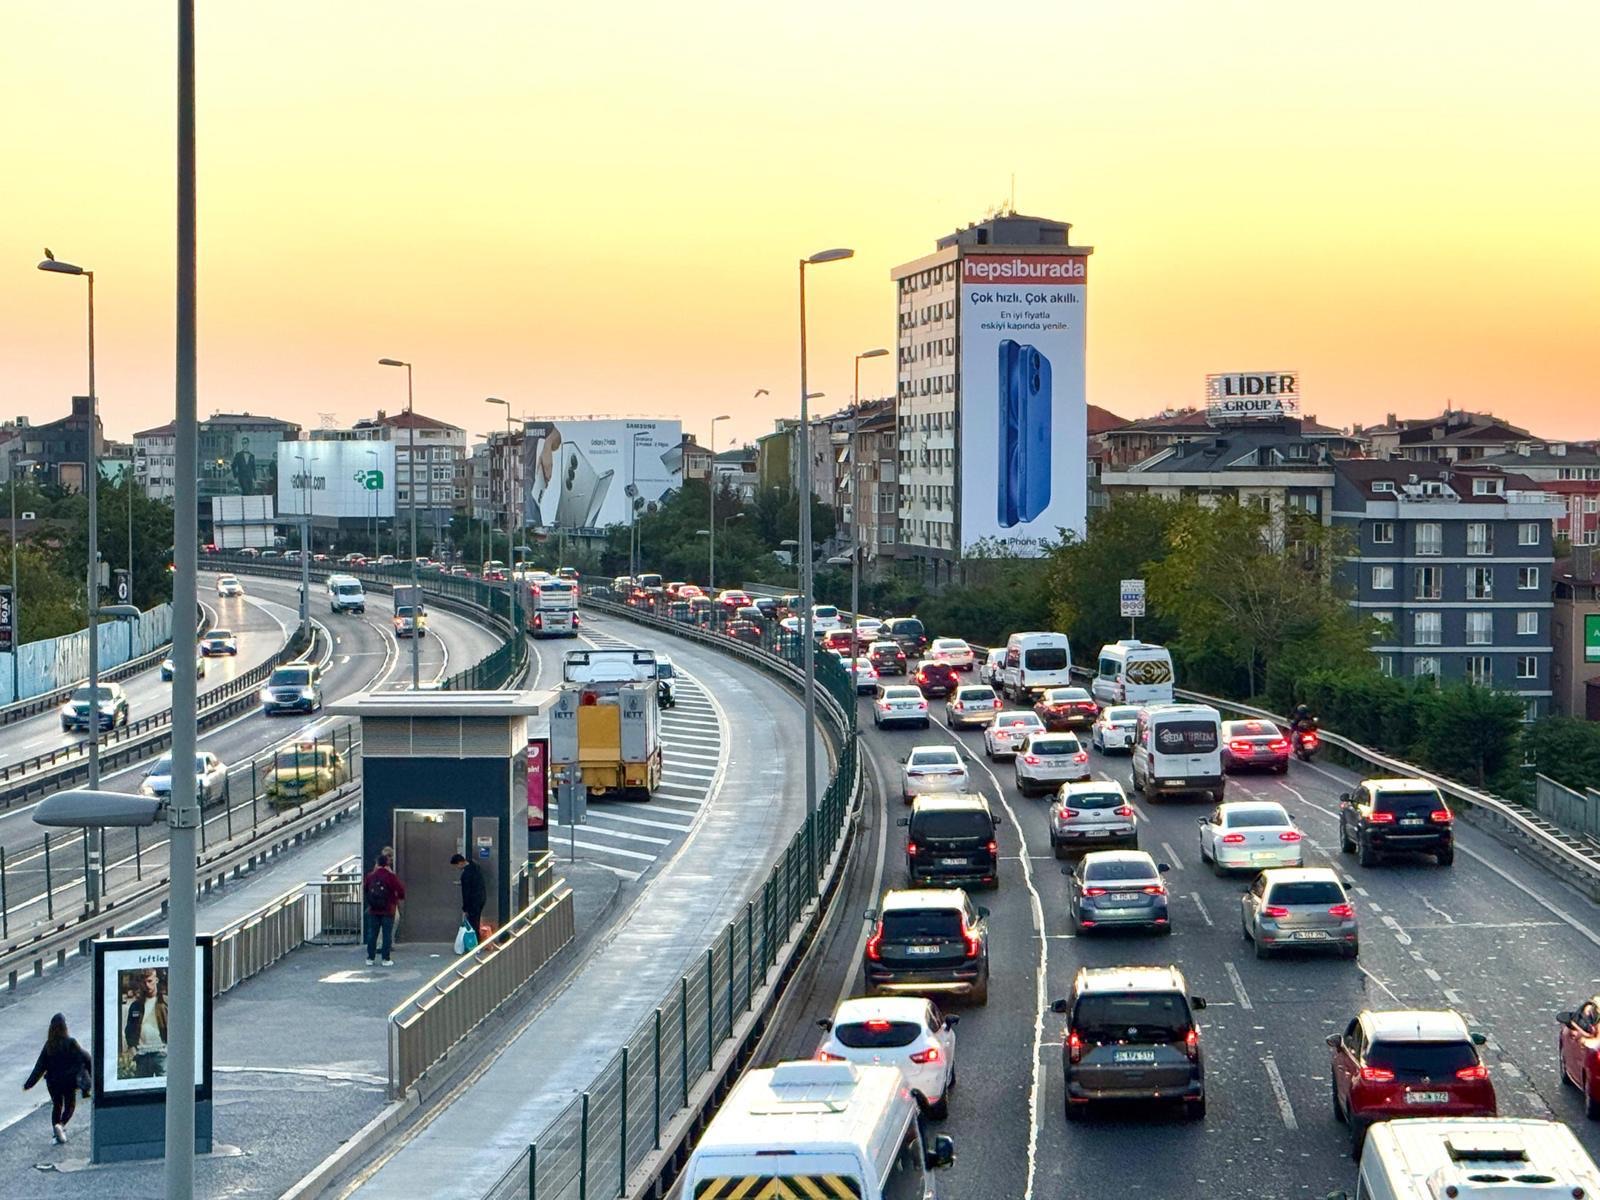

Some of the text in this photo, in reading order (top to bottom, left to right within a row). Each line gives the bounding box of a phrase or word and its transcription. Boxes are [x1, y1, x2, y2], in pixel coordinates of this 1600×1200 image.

[964, 258, 1085, 281] hepsiburada
[970, 292, 994, 305] Çok
[1025, 292, 1048, 305] Çok
[1000, 311, 1012, 319] En
[1024, 311, 1050, 321] fiyatla
[980, 321, 1006, 333] eskiyi
[1224, 373, 1295, 395] LİDER
[1224, 400, 1272, 411] GROUP
[1162, 732, 1184, 743] SEDA
[138, 955, 169, 963] lefties
